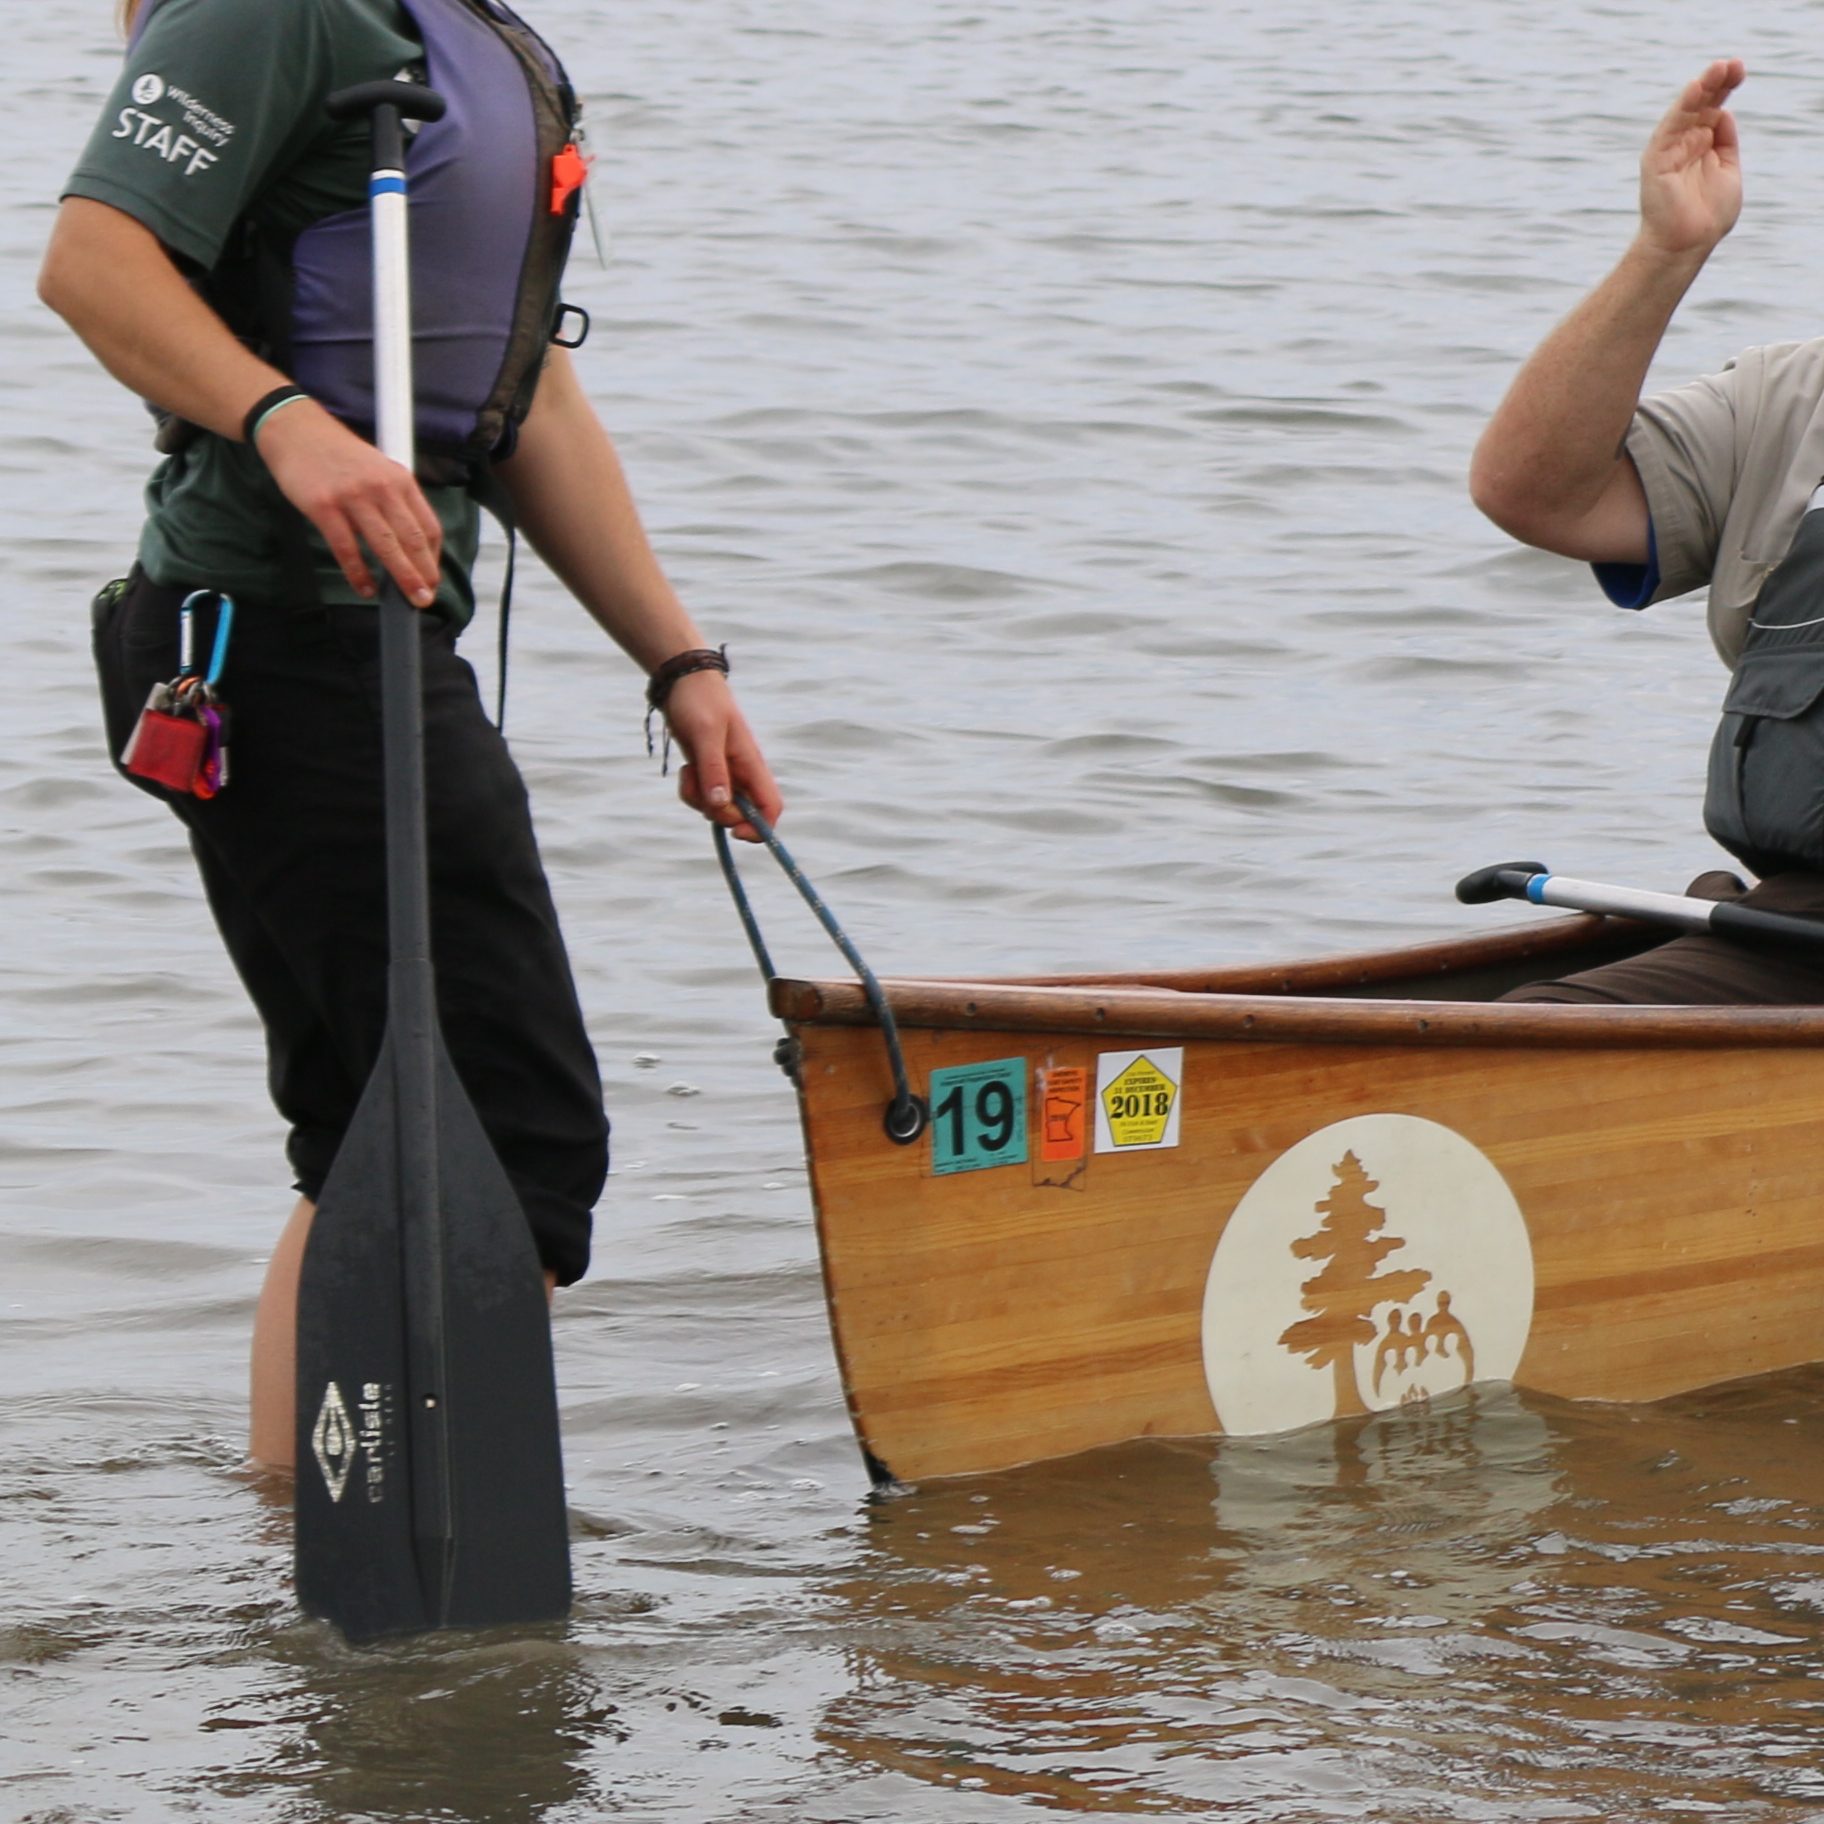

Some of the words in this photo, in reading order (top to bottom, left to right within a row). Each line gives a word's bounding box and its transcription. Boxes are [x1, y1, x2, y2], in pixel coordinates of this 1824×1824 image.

[112, 107, 219, 176] STAFF
[936, 1080, 1015, 1156] 19
[1110, 1092, 1169, 1119] 2018
[358, 1382, 384, 1504] carlisle
